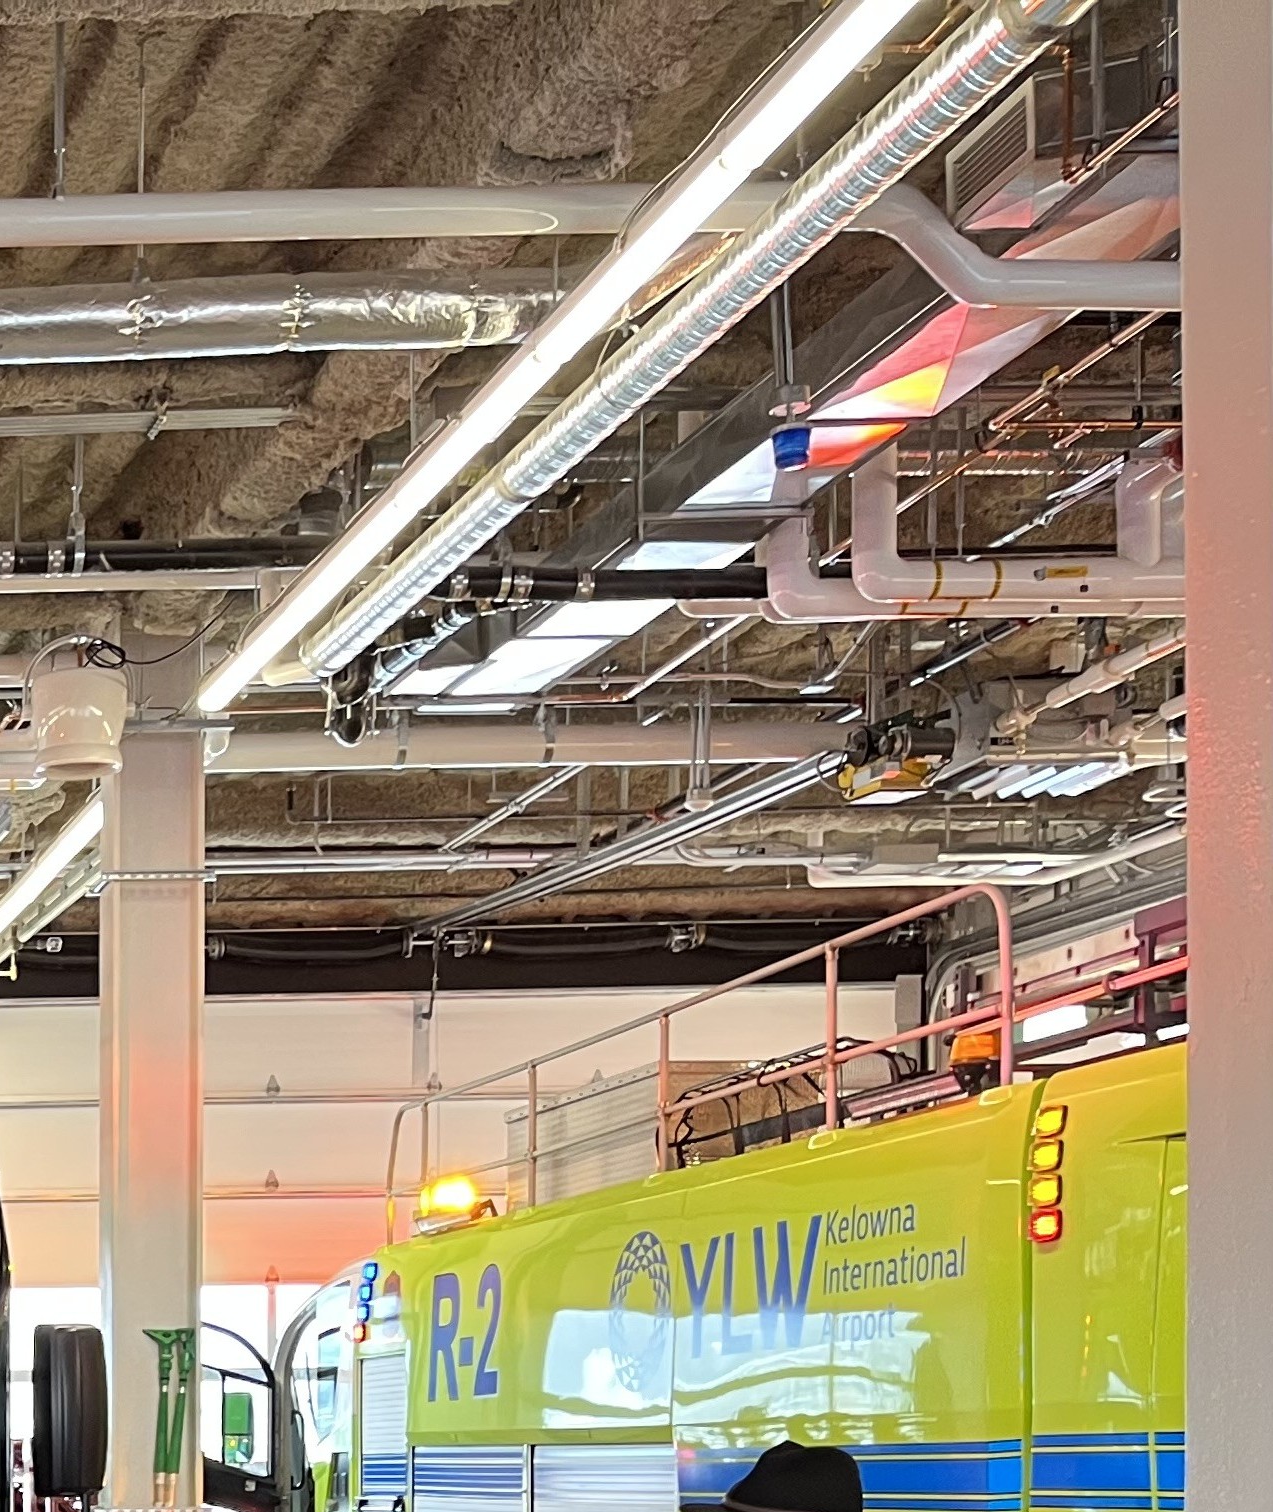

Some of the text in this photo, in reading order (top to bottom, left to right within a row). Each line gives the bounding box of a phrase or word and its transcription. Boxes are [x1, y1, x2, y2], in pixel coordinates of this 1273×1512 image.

[822, 1236, 967, 1296] International
[824, 1203, 916, 1247] Kelowna
[428, 1263, 502, 1402] R-2
[680, 1214, 823, 1359] YLW
